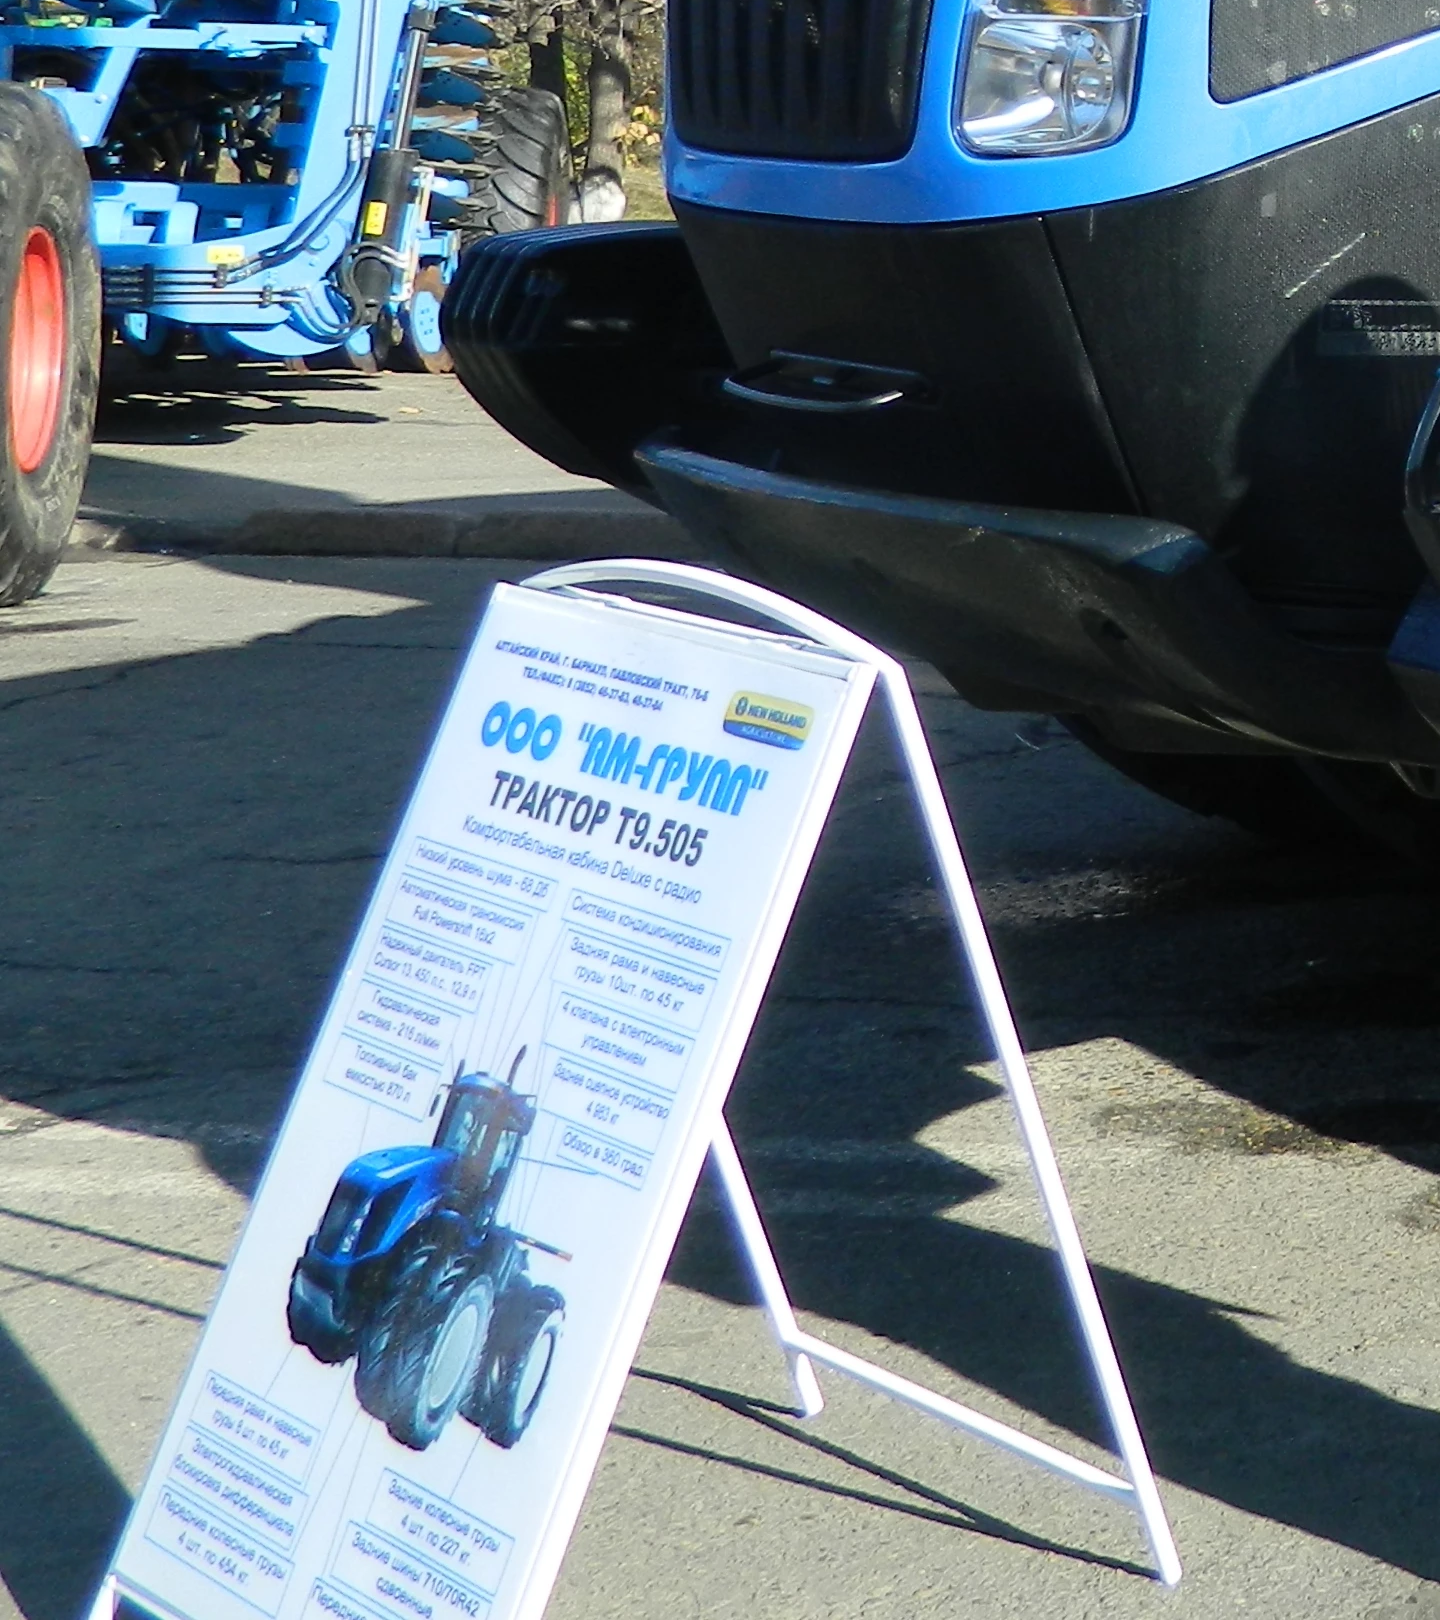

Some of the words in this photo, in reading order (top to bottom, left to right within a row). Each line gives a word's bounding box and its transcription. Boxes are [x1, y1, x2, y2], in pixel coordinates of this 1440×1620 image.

[481, 700, 562, 762] ООО
[579, 722, 769, 817] "АМ-ГРУПП"
[488, 770, 610, 836] ТРАКТОР
[614, 806, 710, 868] Т9.505
[463, 814, 567, 864] Комфортабельная
[567, 844, 608, 877] кабина
[610, 858, 651, 888] Deluxe
[662, 879, 702, 905] радио
[486, 870, 513, 887] шума
[413, 905, 430, 921] Full
[430, 911, 473, 937] Powershift
[572, 896, 617, 922] Система
[618, 912, 722, 958] кондиционирования
[570, 936, 610, 960] Задняя
[610, 954, 640, 973] рама
[651, 967, 706, 995] навесные
[574, 964, 606, 984] грузы
[640, 988, 655, 1002] по
[656, 992, 671, 1008] 45
[580, 1034, 647, 1067] управлением
[402, 1064, 418, 1082] бак
[562, 1131, 592, 1158] Обзор
[351, 1531, 393, 1566] Задние
[390, 1557, 424, 1584] шины
[425, 1532, 440, 1547] по
[470, 1528, 501, 1554] грузы
[312, 1584, 367, 1620] Передн
